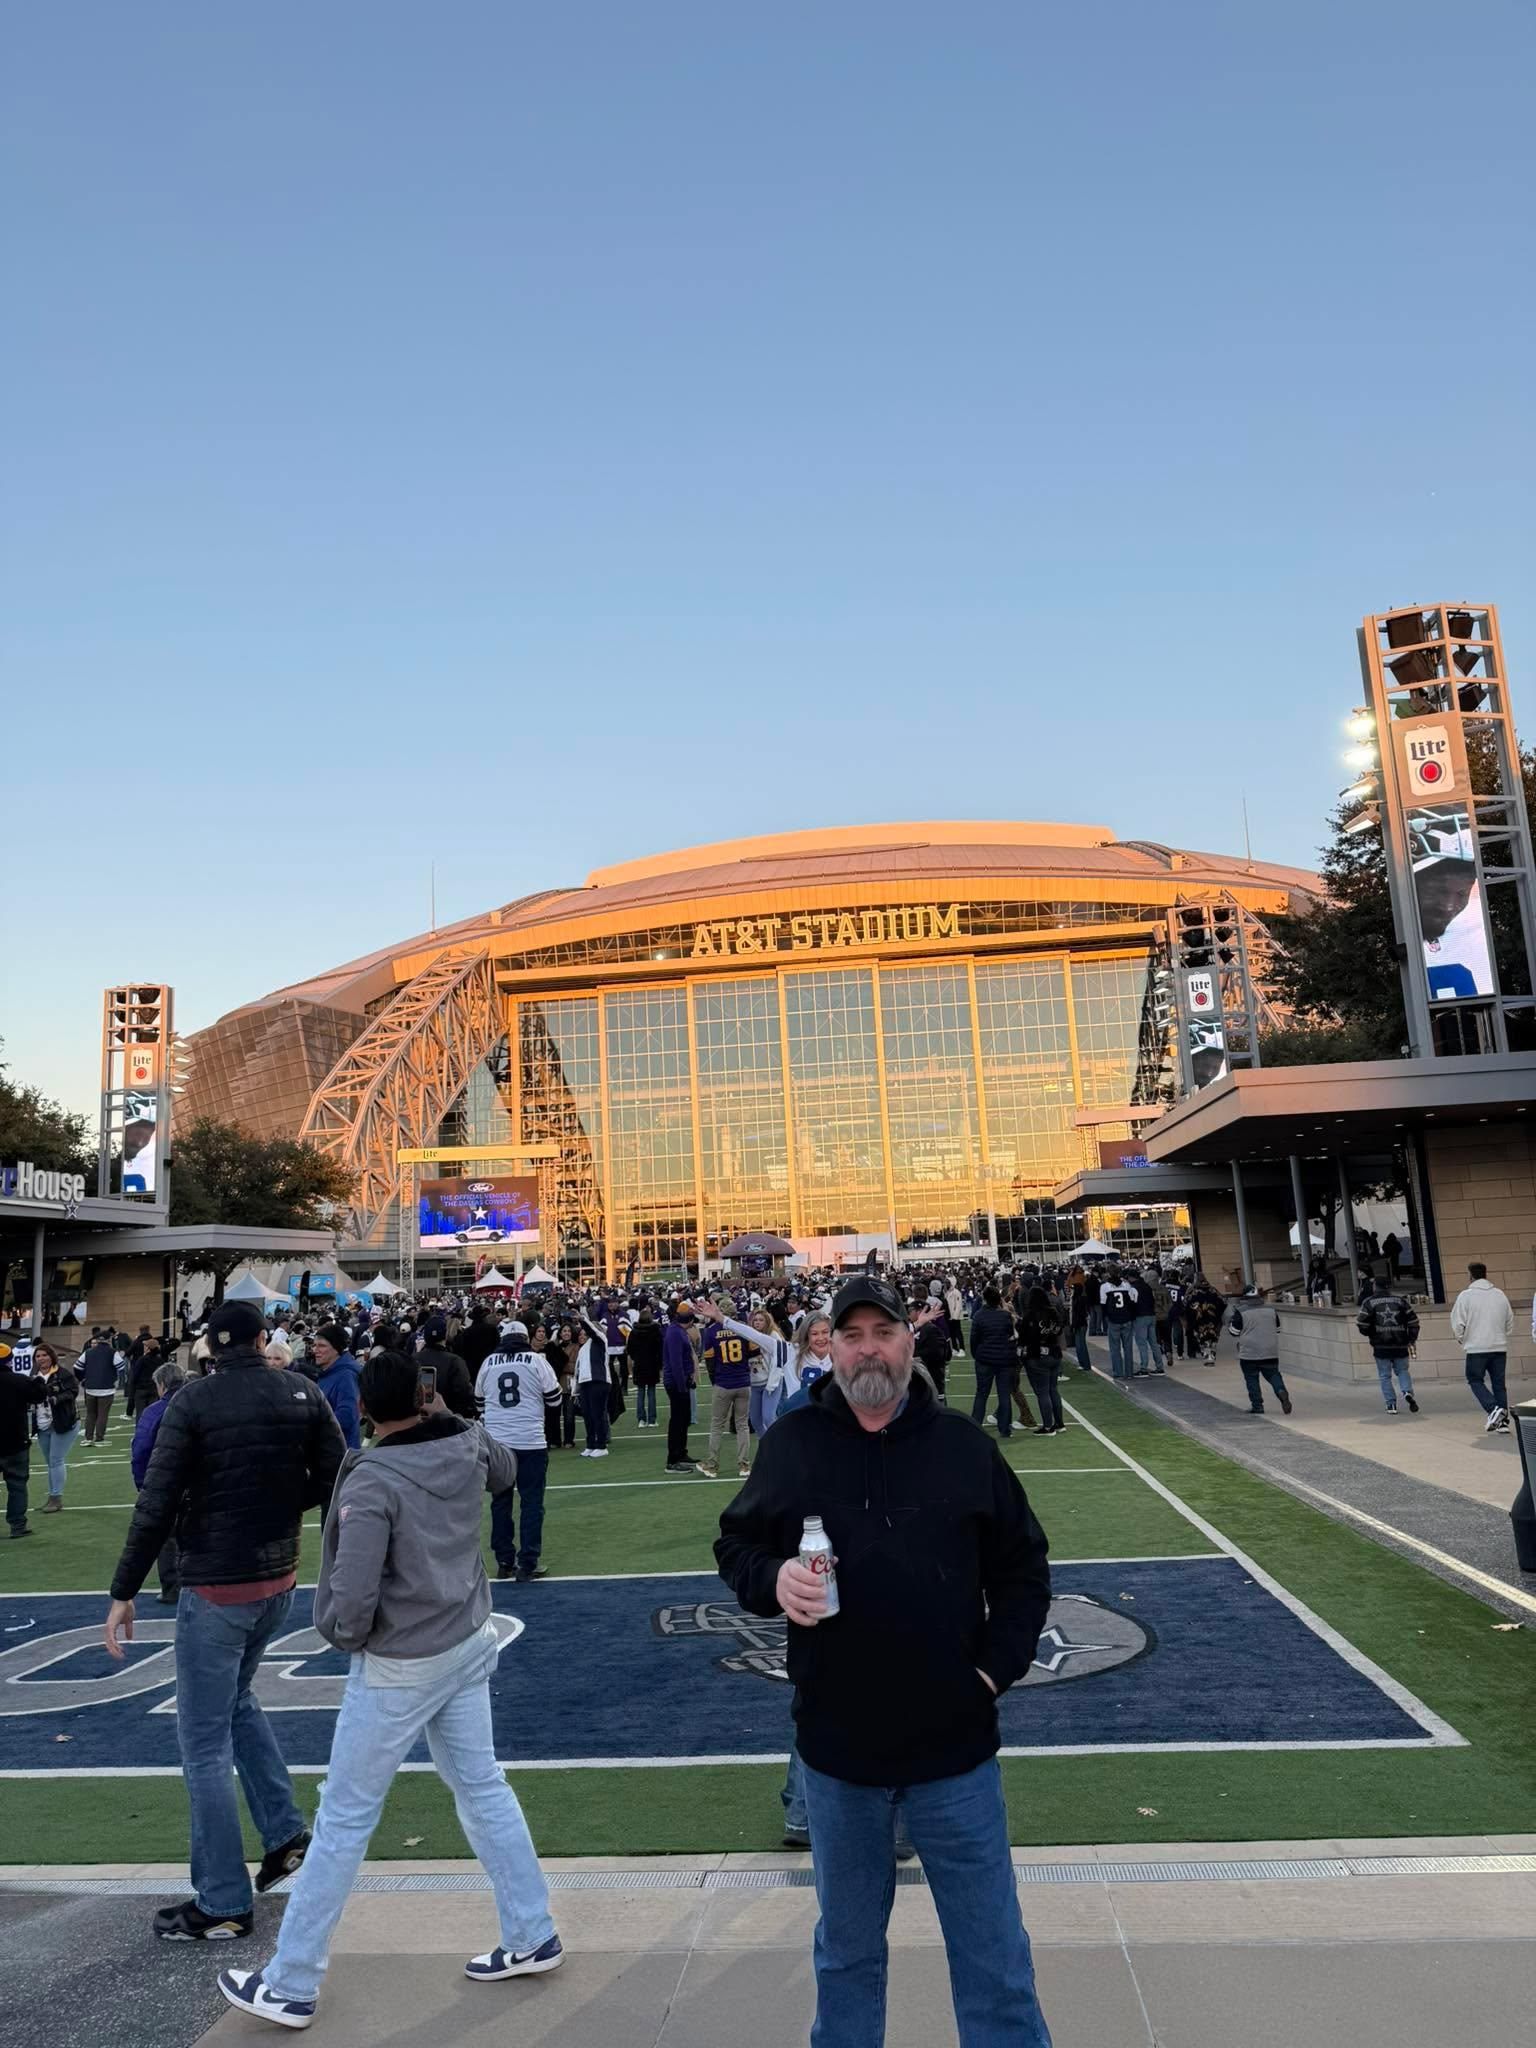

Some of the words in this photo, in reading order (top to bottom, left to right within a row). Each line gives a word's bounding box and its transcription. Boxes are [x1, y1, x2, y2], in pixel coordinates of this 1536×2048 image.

[1410, 740, 1446, 760] Lite
[691, 918, 781, 957] AT&T
[791, 904, 963, 949] STADIUM
[1191, 981, 1210, 992] Lite
[133, 1056, 151, 1066] Lite
[423, 1150, 438, 1159] Lite
[1114, 1292, 1124, 1308] 3
[719, 1339, 743, 1364] 18
[14, 1355, 31, 1371] 88
[488, 1354, 532, 1367] AIKMAN
[498, 1371, 520, 1408] 8
